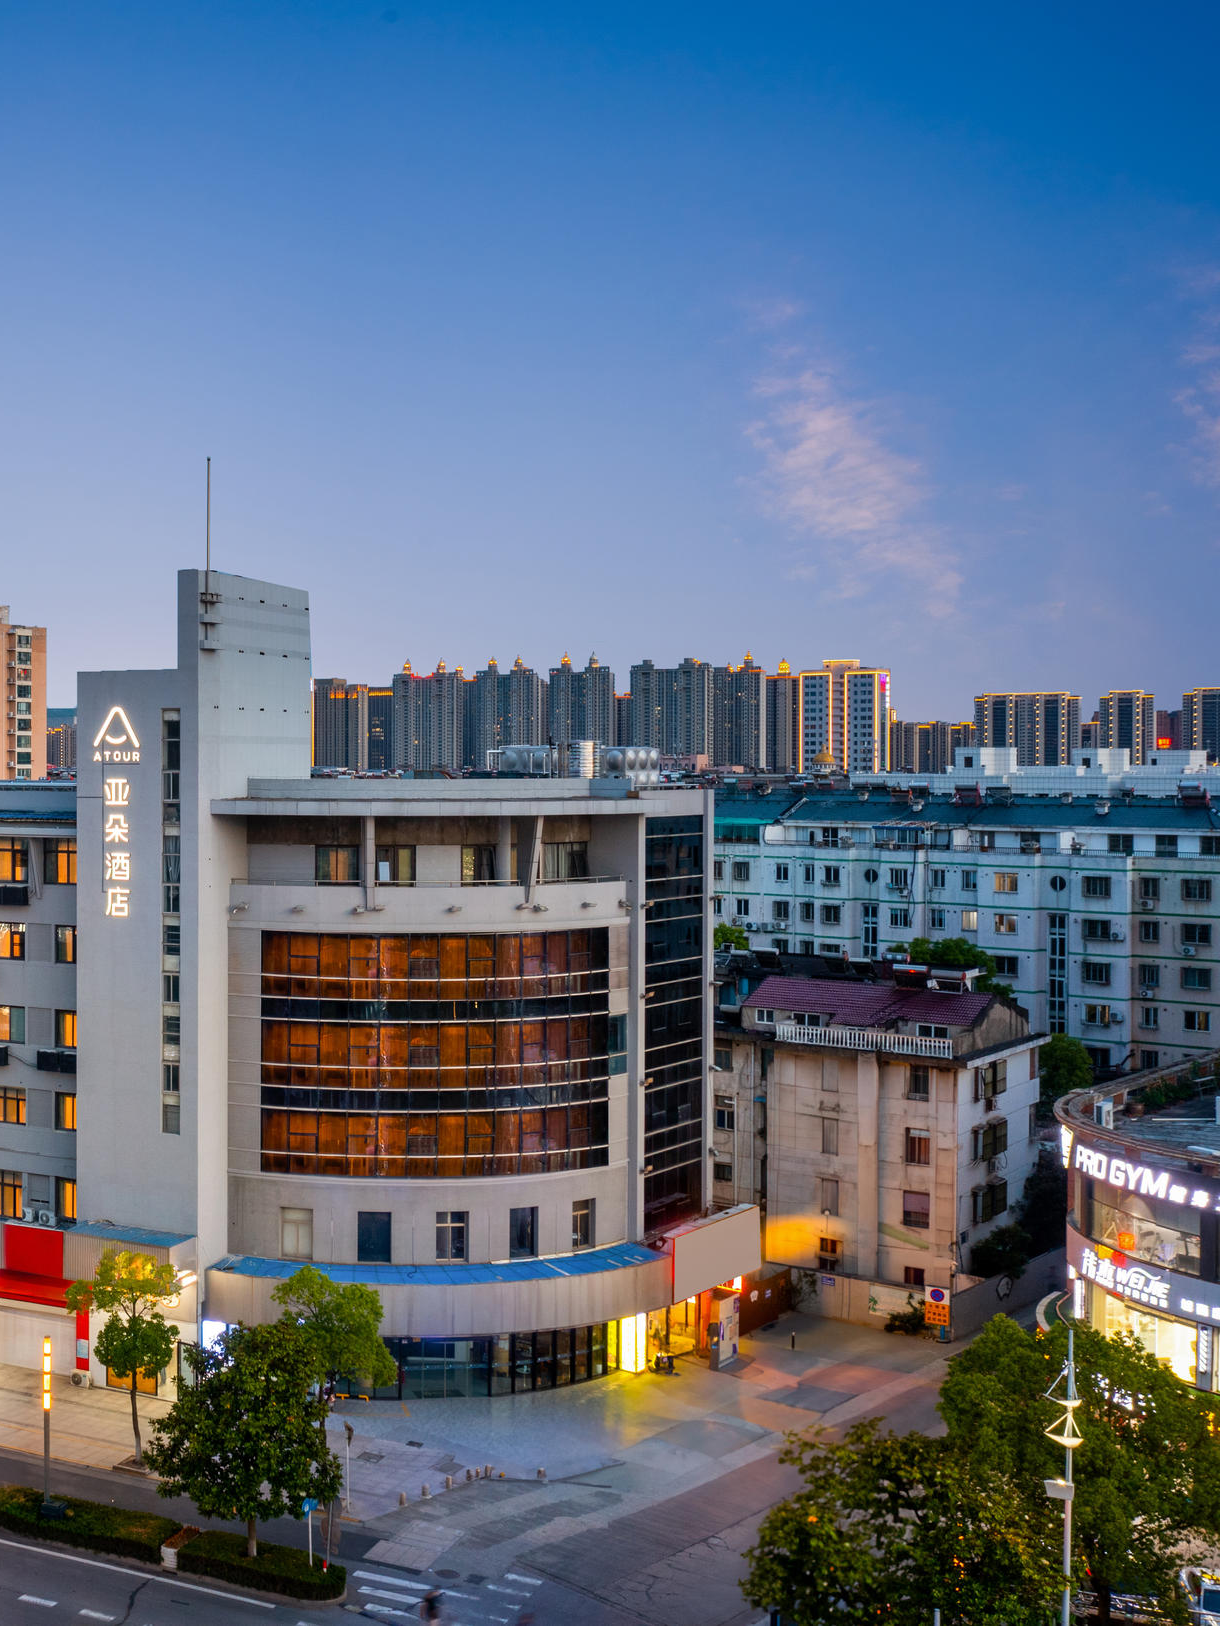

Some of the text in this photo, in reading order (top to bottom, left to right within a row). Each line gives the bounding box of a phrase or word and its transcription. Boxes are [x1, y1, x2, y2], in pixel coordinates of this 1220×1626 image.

[93, 751, 140, 762] ATOUR
[104, 778, 130, 917] 亚朵酒店
[1075, 1144, 1108, 1180] PRO
[1109, 1158, 1171, 1199] GYM
